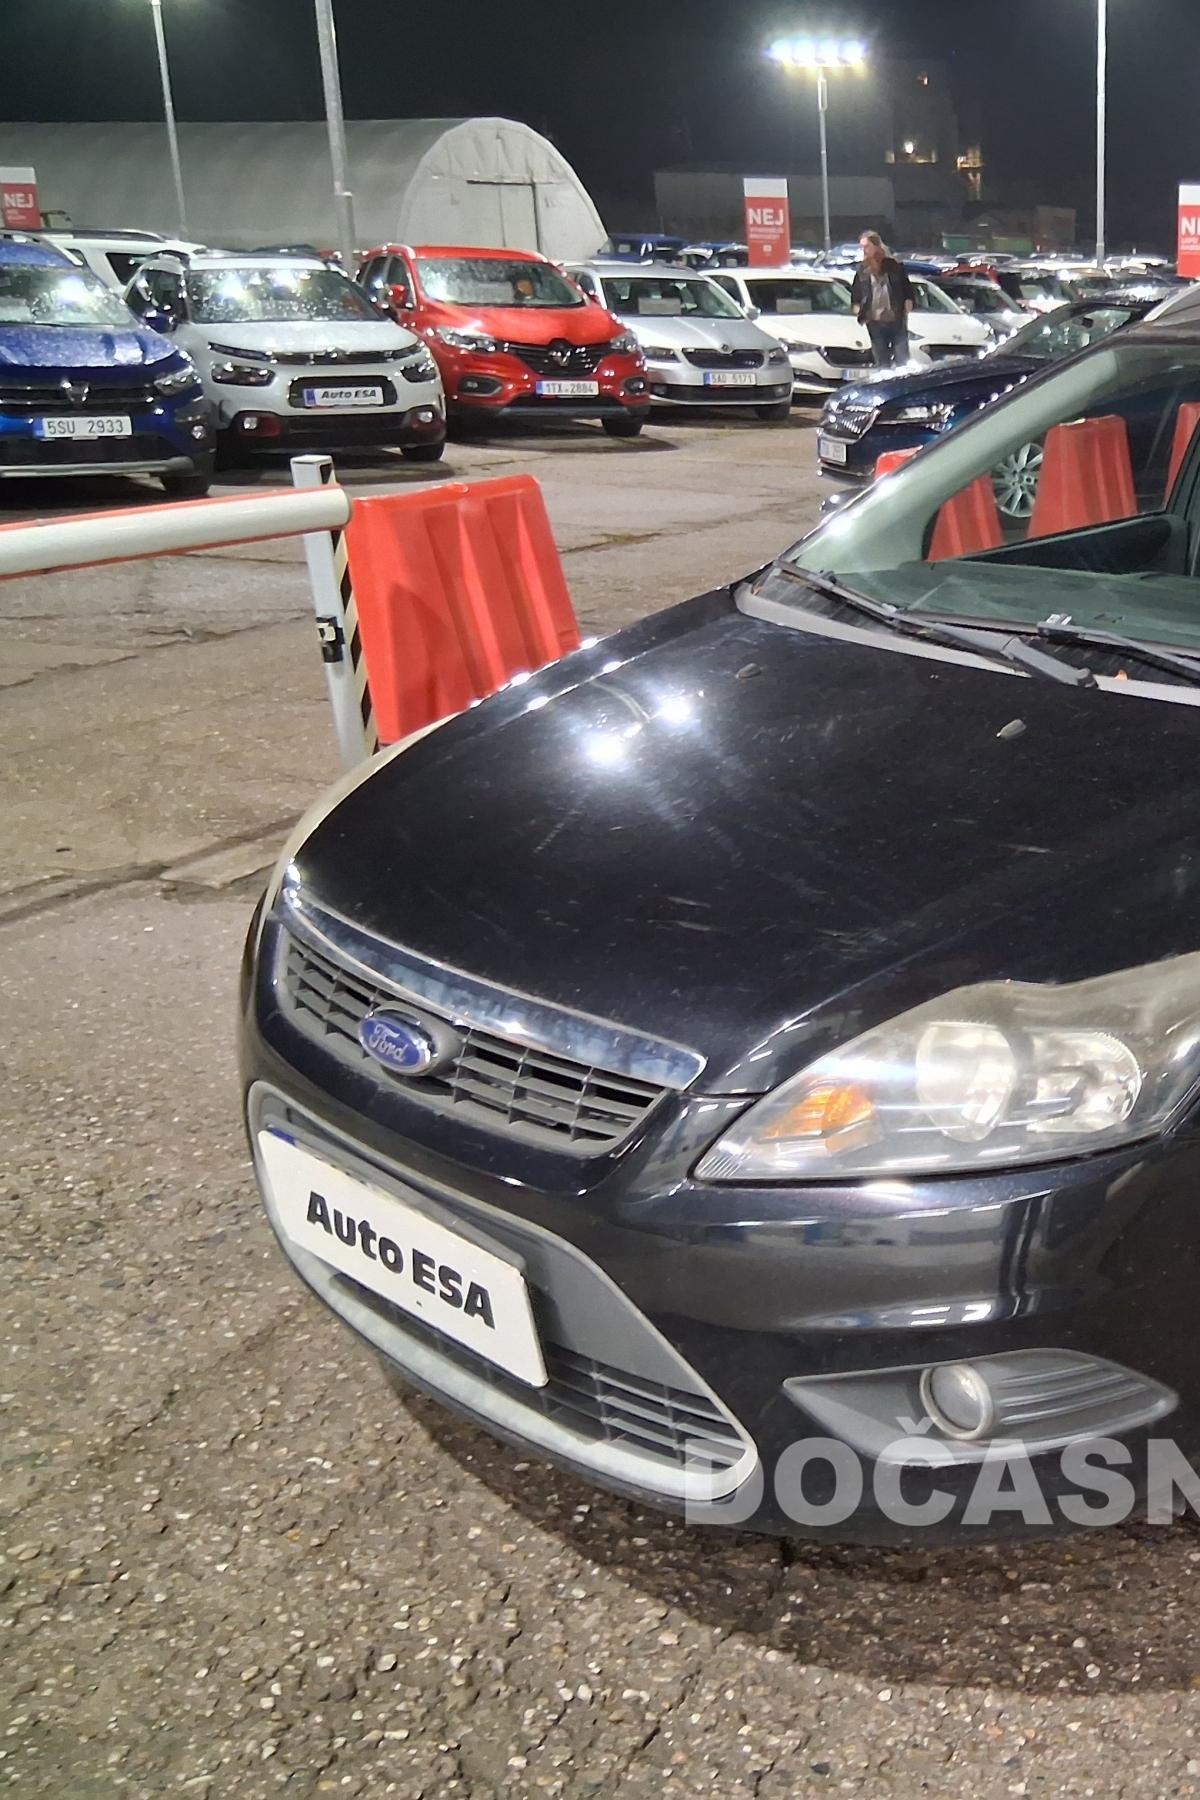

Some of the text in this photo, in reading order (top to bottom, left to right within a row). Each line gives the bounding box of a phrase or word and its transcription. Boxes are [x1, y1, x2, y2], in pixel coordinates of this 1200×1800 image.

[4, 193, 34, 208] NEJ
[748, 208, 784, 225] NEJ
[321, 389, 376, 399] Auto ESA
[47, 419, 124, 435] 5SU 2933
[368, 1023, 409, 1063] Ford
[306, 1190, 496, 1330] Auto ESA
